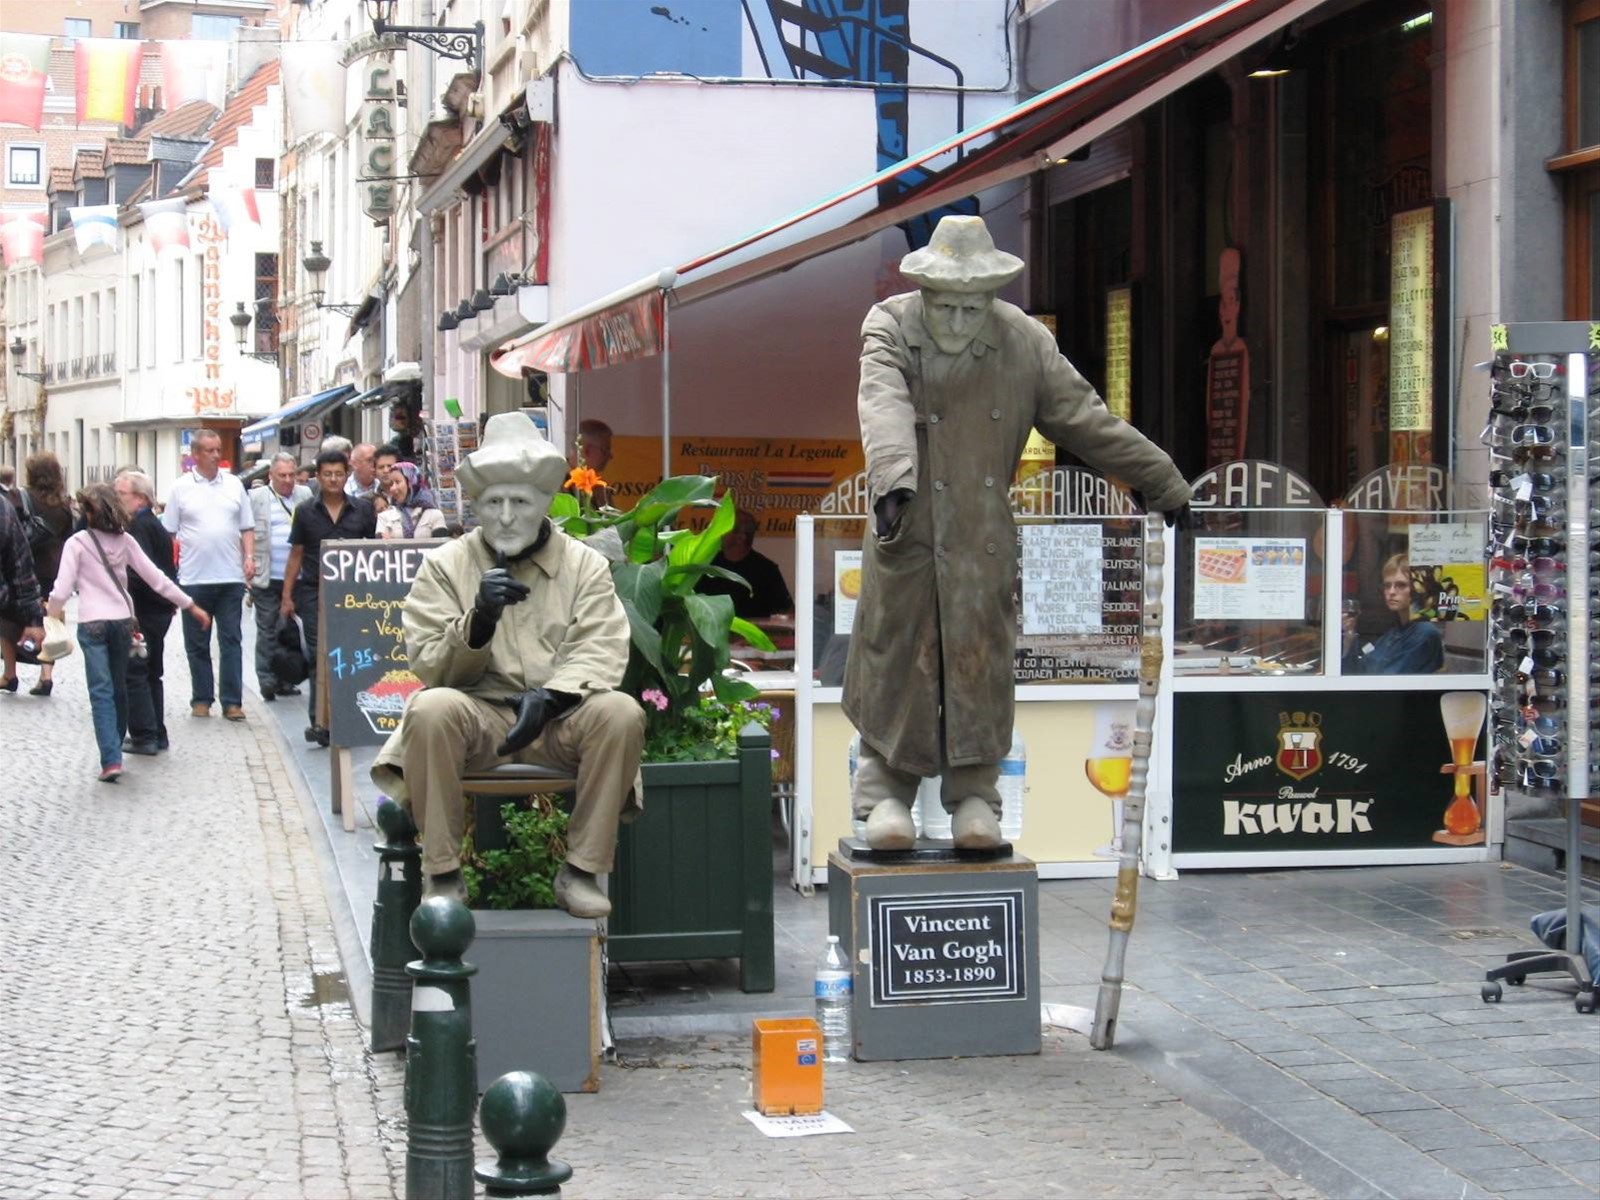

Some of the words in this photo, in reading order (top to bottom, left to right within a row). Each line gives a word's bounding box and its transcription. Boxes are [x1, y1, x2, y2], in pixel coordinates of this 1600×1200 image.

[366, 67, 397, 213] LACE
[681, 442, 760, 459] Restaurant
[764, 444, 784, 458] La
[788, 444, 848, 462] Legende
[1189, 462, 1311, 507] CAFE
[1224, 753, 1273, 784] Anno
[1327, 751, 1369, 774] 1791
[903, 914, 992, 934] Vincent
[893, 943, 935, 962] Van
[942, 940, 1002, 965] Gogh
[903, 966, 996, 985] 1853-1890
